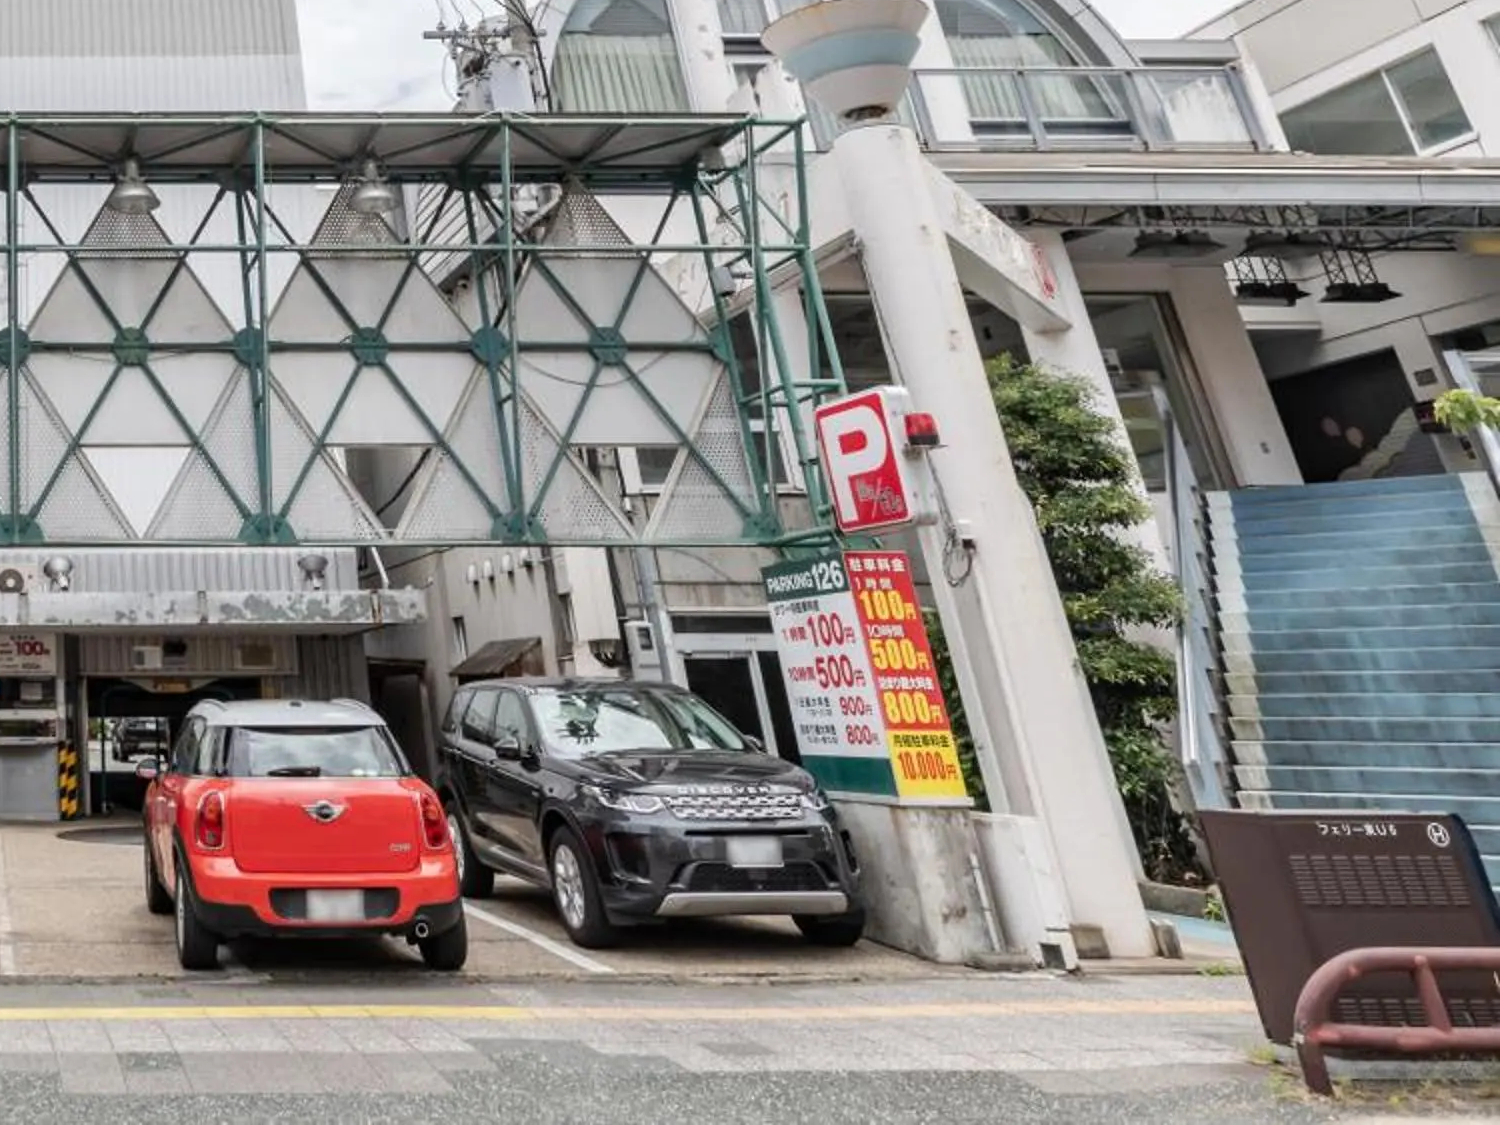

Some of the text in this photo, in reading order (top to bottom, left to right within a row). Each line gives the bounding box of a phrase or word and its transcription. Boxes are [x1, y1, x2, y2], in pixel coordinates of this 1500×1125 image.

[820, 404, 887, 523] P
[766, 560, 845, 594] PARKING 126
[858, 589, 917, 621] 100円
[868, 638, 930, 671] 500円
[883, 690, 944, 724] 800円
[677, 784, 780, 795] DISCOVER
